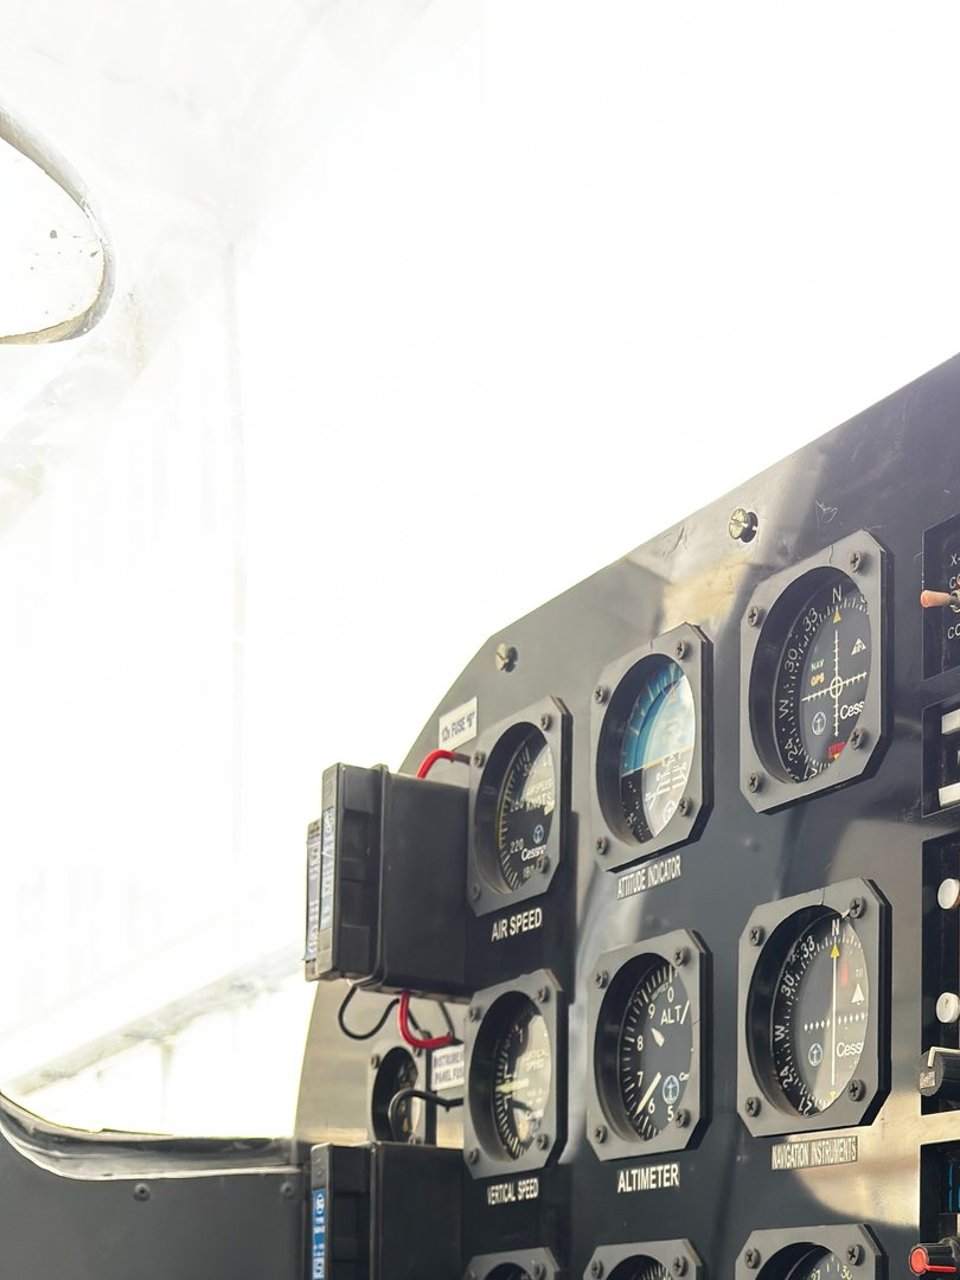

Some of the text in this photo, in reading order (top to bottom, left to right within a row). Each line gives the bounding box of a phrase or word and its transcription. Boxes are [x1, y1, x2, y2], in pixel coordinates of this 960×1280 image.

[832, 585, 842, 602] N
[492, 908, 542, 942] AIR SPEED
[832, 919, 840, 936] N
[667, 987, 674, 1003] 0
[648, 1004, 656, 1020] 9
[660, 1005, 682, 1026] ALT
[637, 1035, 644, 1051] 8
[637, 1071, 644, 1087] 7
[648, 1098, 655, 1114] 6
[667, 1106, 674, 1122] 5
[618, 1162, 680, 1193] ALTIMETER
[487, 1178, 539, 1205] VERTICAL SPEED
